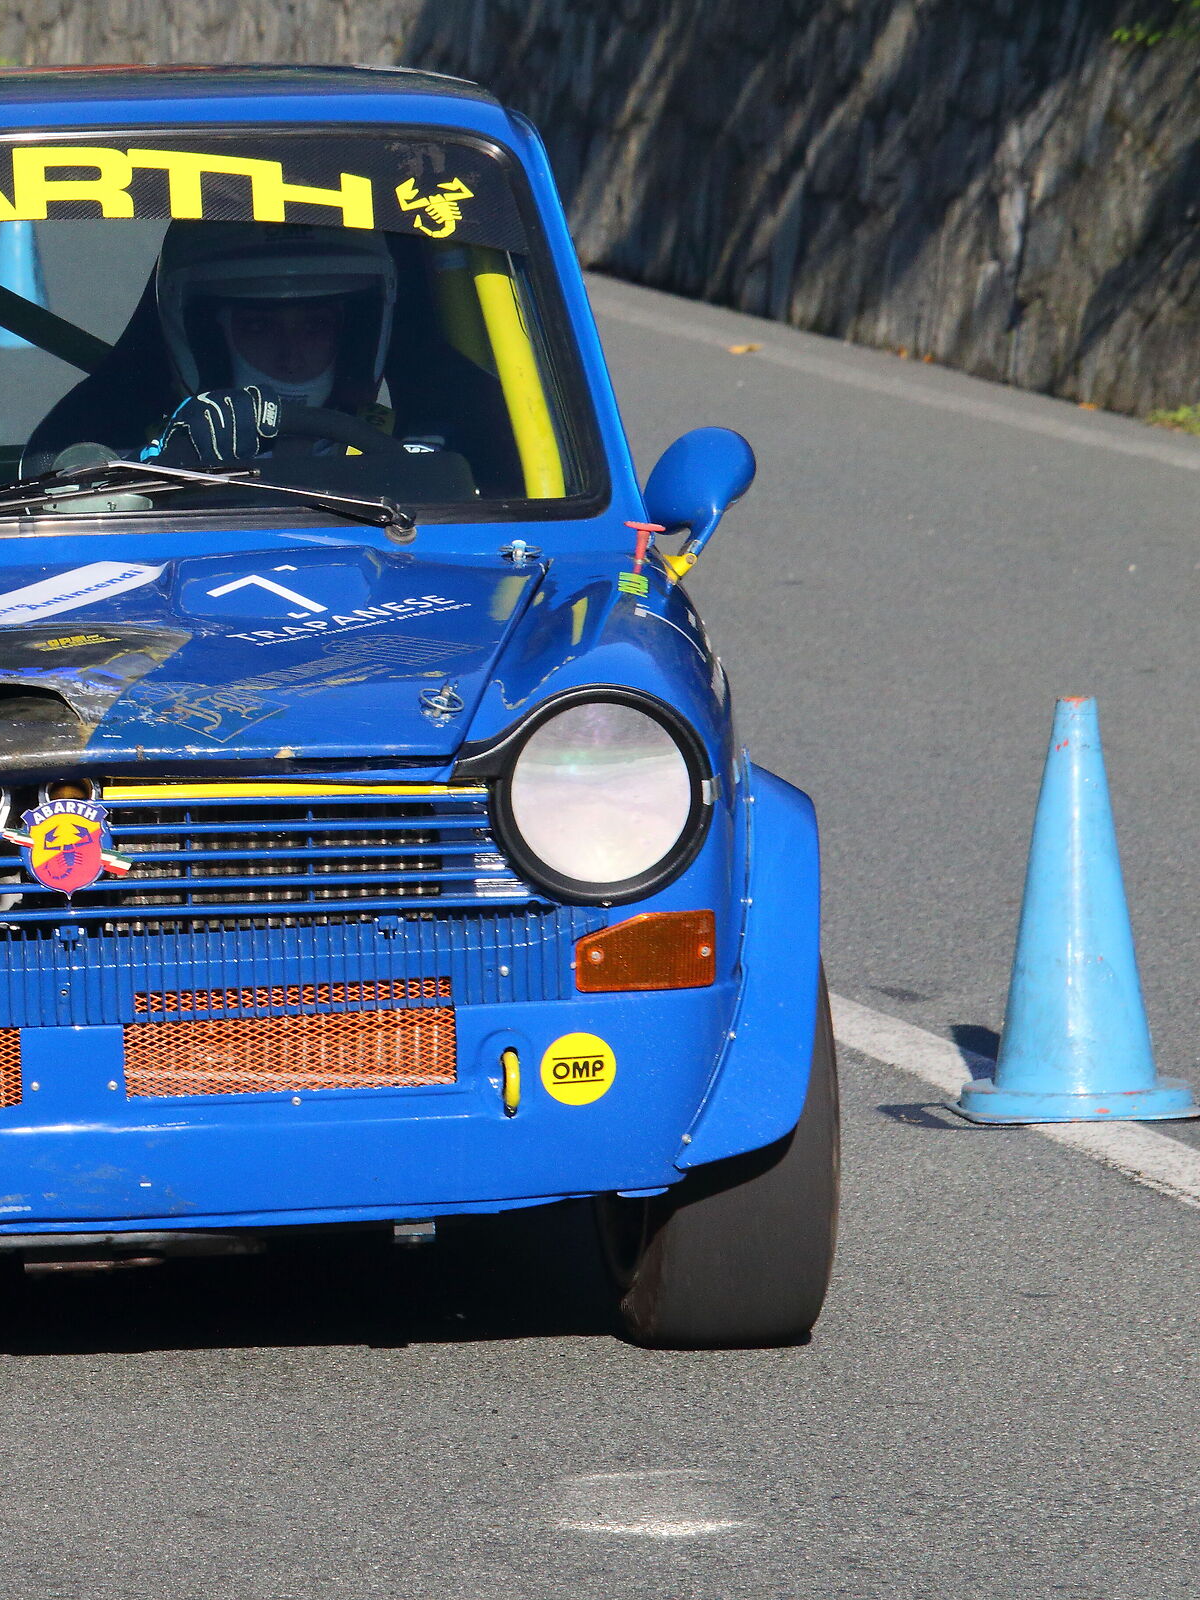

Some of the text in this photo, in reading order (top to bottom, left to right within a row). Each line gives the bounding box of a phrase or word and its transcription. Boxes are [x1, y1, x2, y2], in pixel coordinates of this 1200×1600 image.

[25, 569, 145, 611] Antincendi
[225, 594, 456, 642] TRAPANESE
[32, 800, 99, 825] ABARTH
[552, 1059, 605, 1080] OMP
